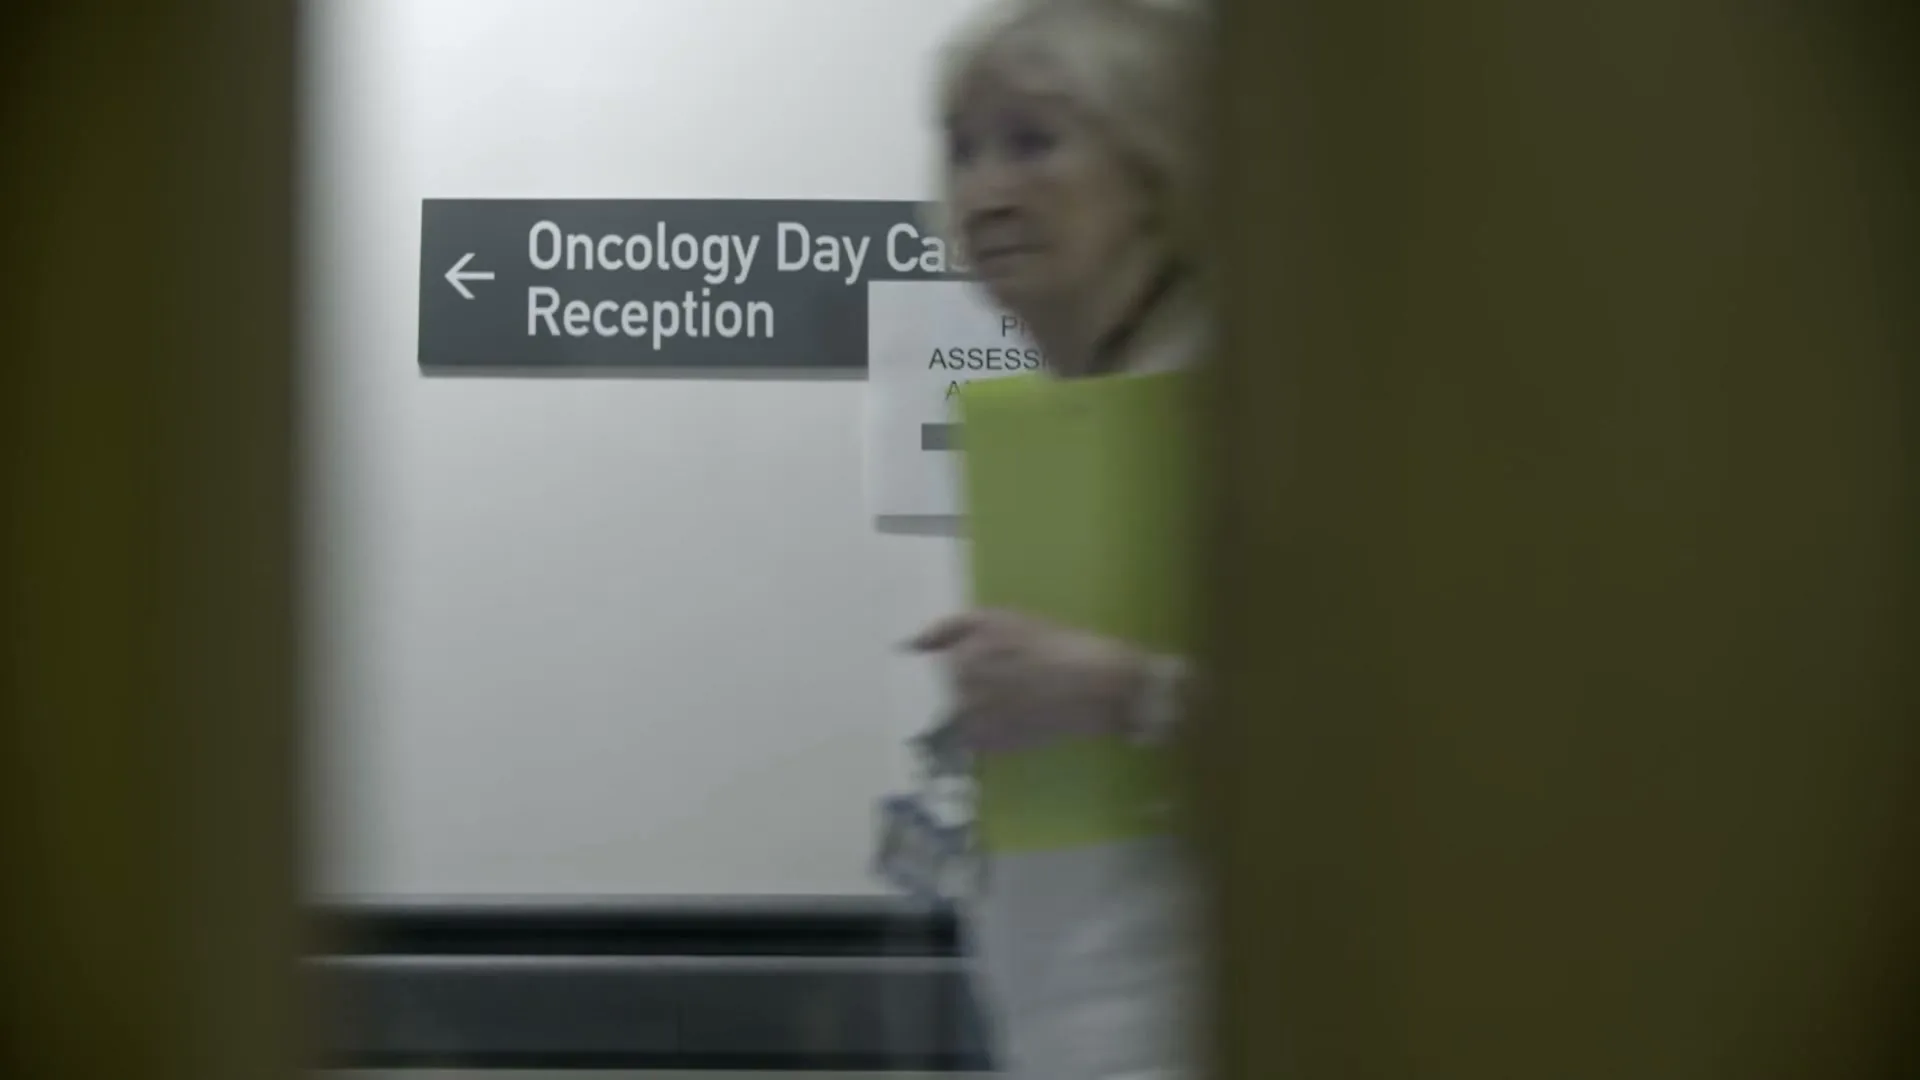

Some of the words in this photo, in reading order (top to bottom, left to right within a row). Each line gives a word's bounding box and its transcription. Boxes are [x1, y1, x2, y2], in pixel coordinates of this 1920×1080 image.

[528, 220, 760, 284] Oncology
[777, 221, 871, 285] Day
[527, 286, 774, 350] Reception
[928, 348, 1049, 370] ASSESS
